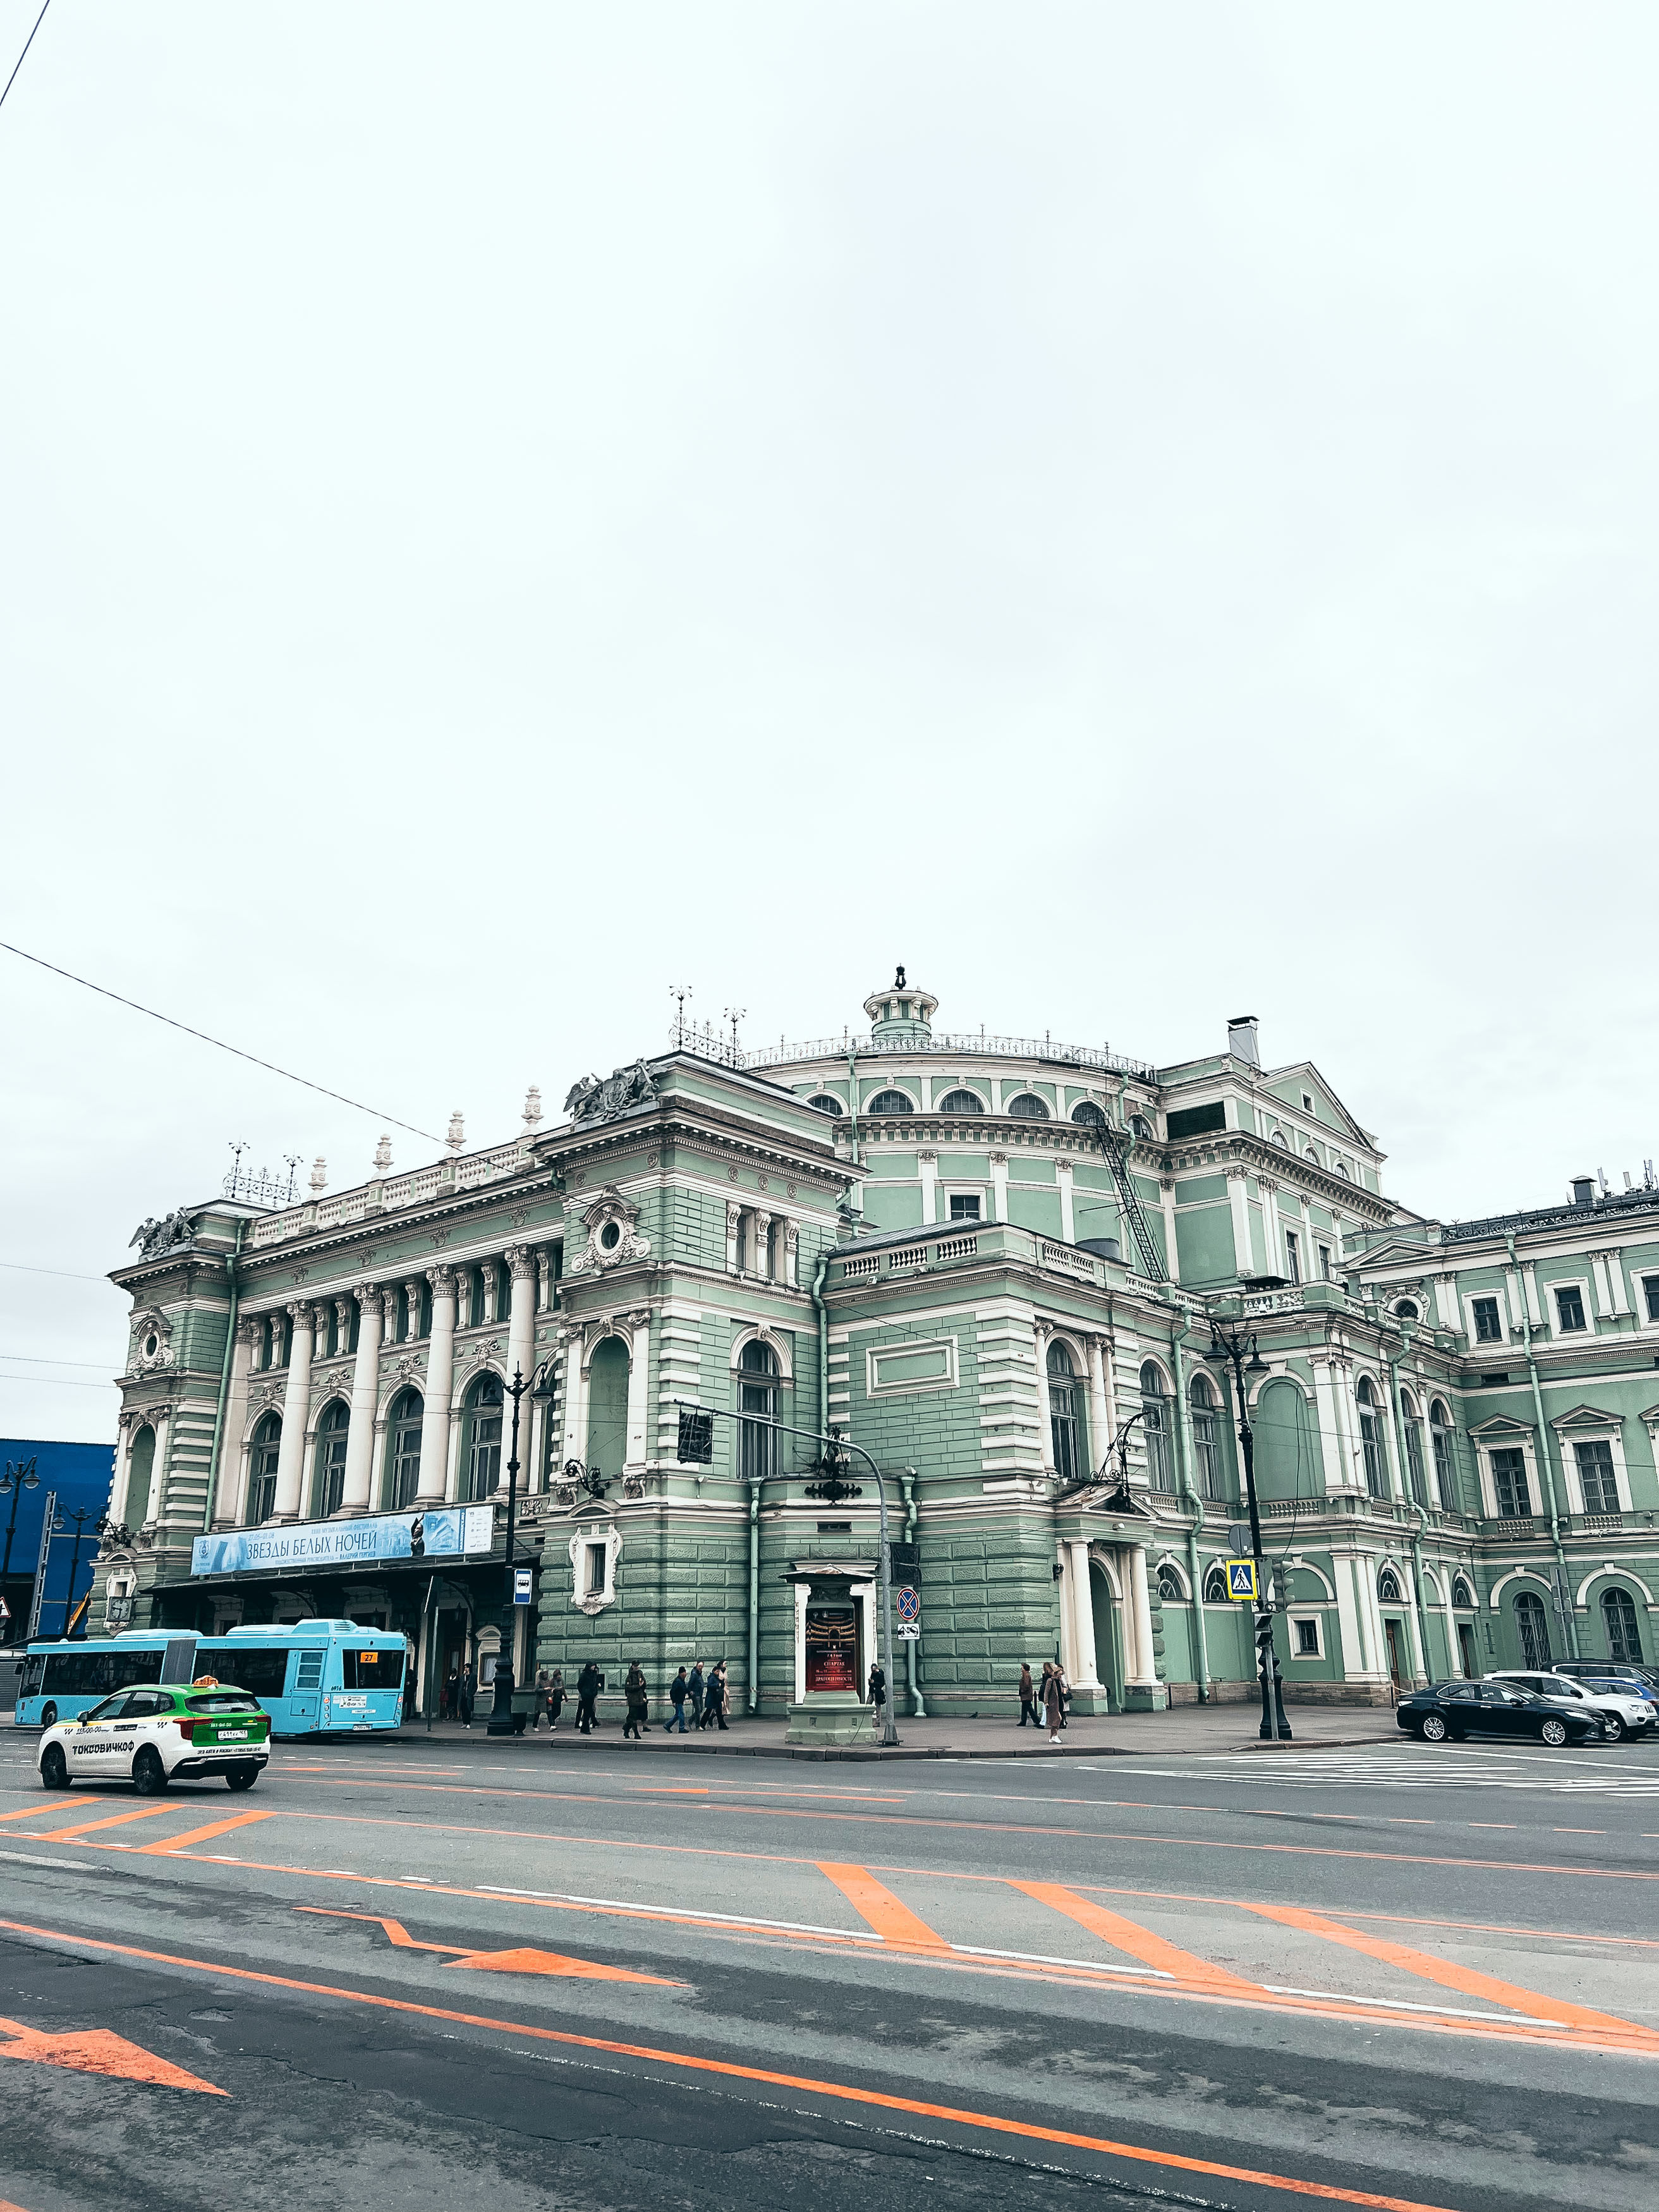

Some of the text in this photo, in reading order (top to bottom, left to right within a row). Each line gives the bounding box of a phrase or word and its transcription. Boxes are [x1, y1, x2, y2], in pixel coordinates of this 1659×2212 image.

[246, 1530, 377, 1560] ЗВЕЗДЫ БЕЛЫХ НОЧЕЙ
